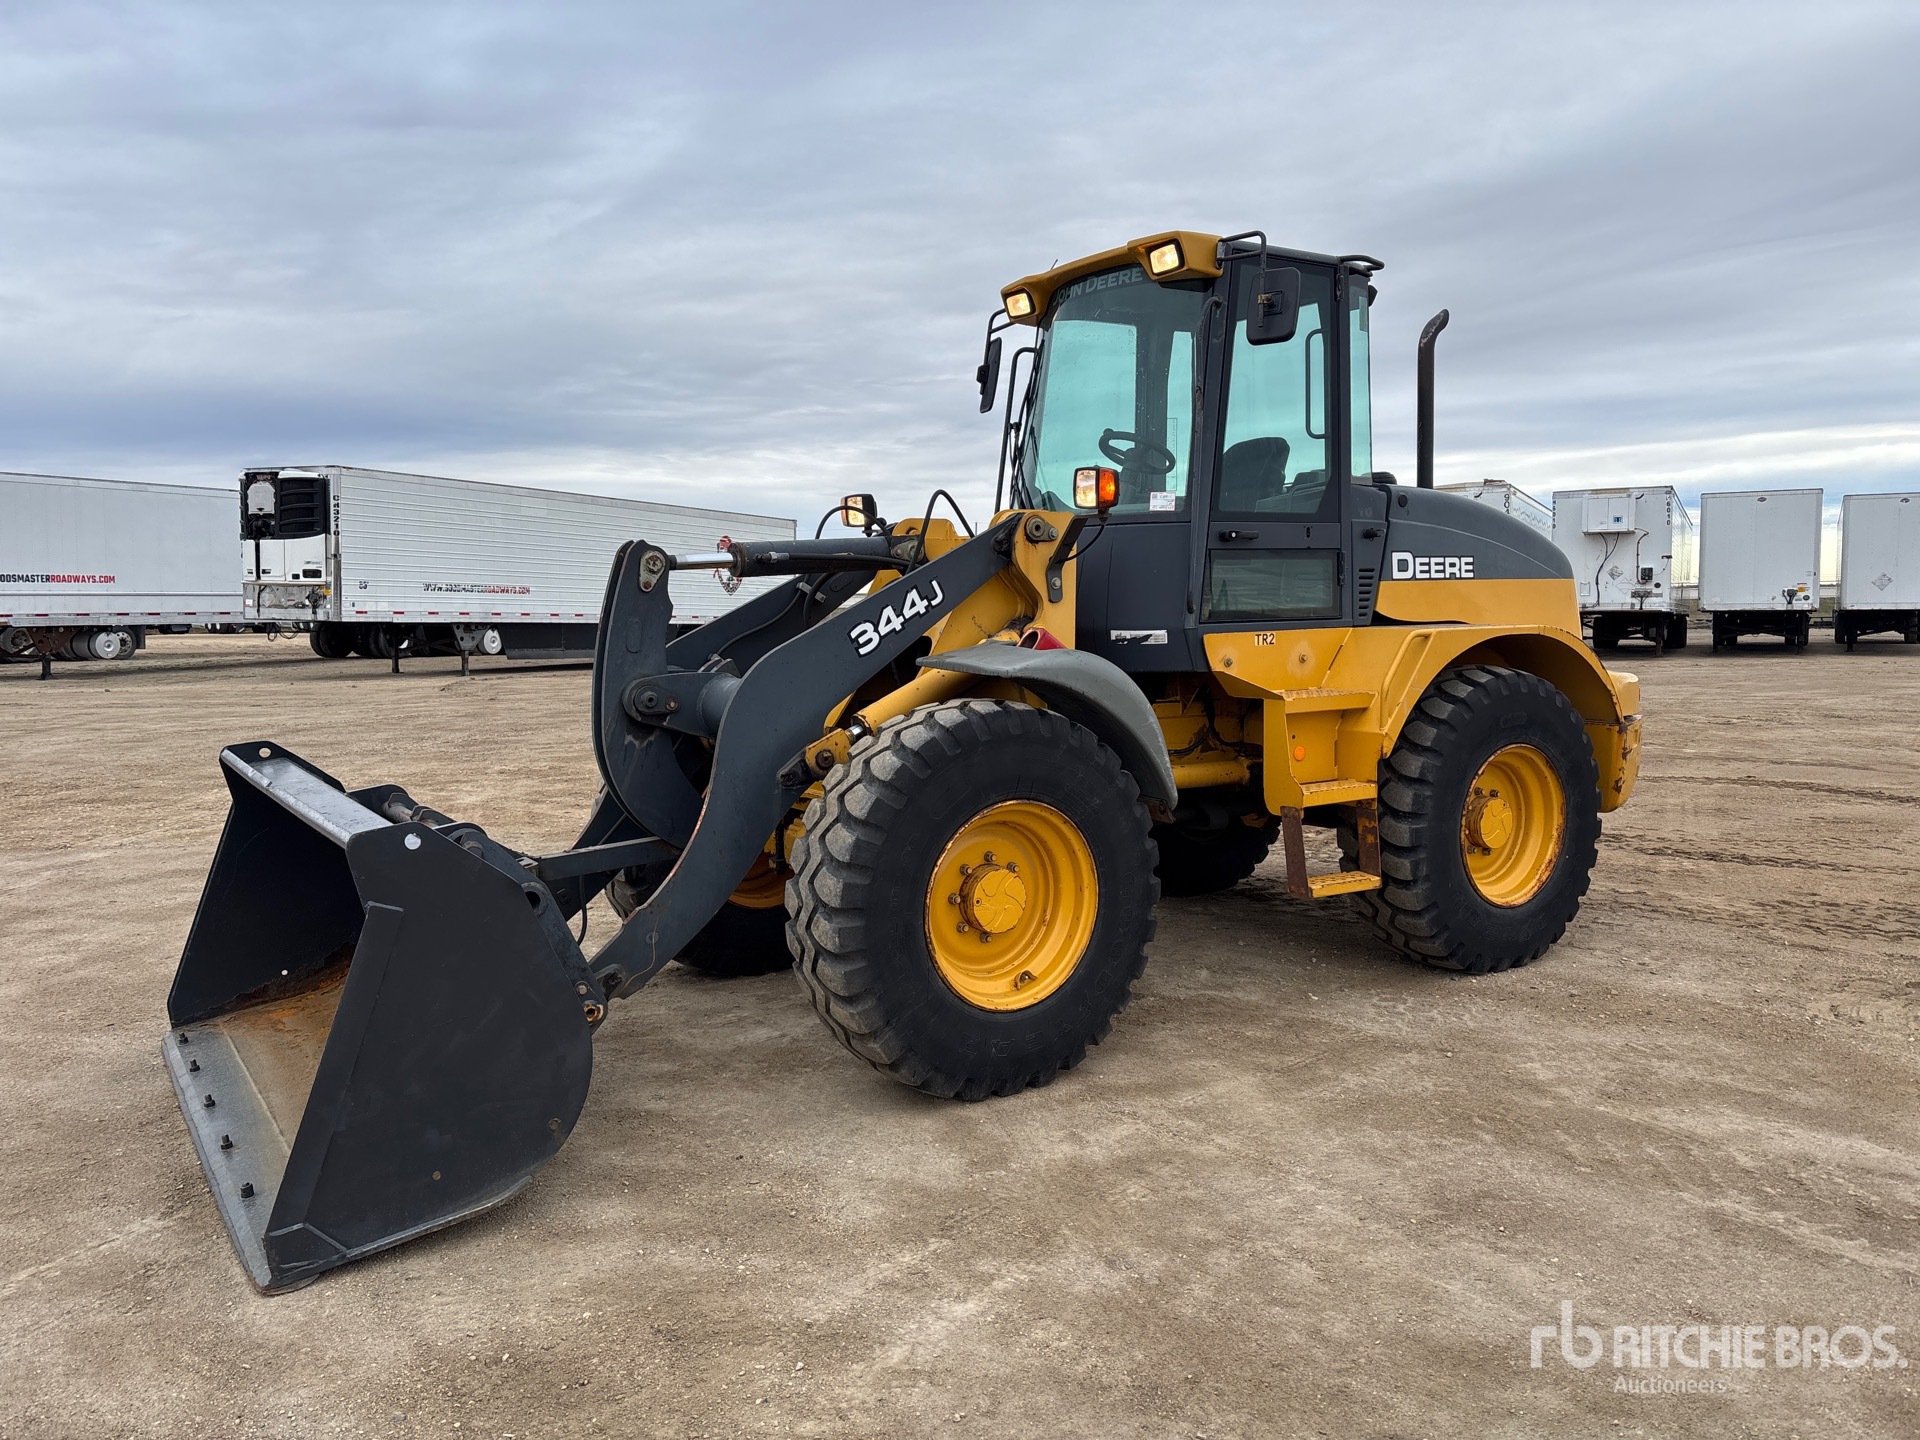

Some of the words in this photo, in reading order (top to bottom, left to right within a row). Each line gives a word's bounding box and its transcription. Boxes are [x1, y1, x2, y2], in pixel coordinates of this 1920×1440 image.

[1053, 282, 1083, 305] JOHN
[1086, 267, 1143, 293] DEERE
[1391, 551, 1475, 580] DEERE
[849, 579, 944, 656] 344J
[1255, 633, 1275, 646] TR2
